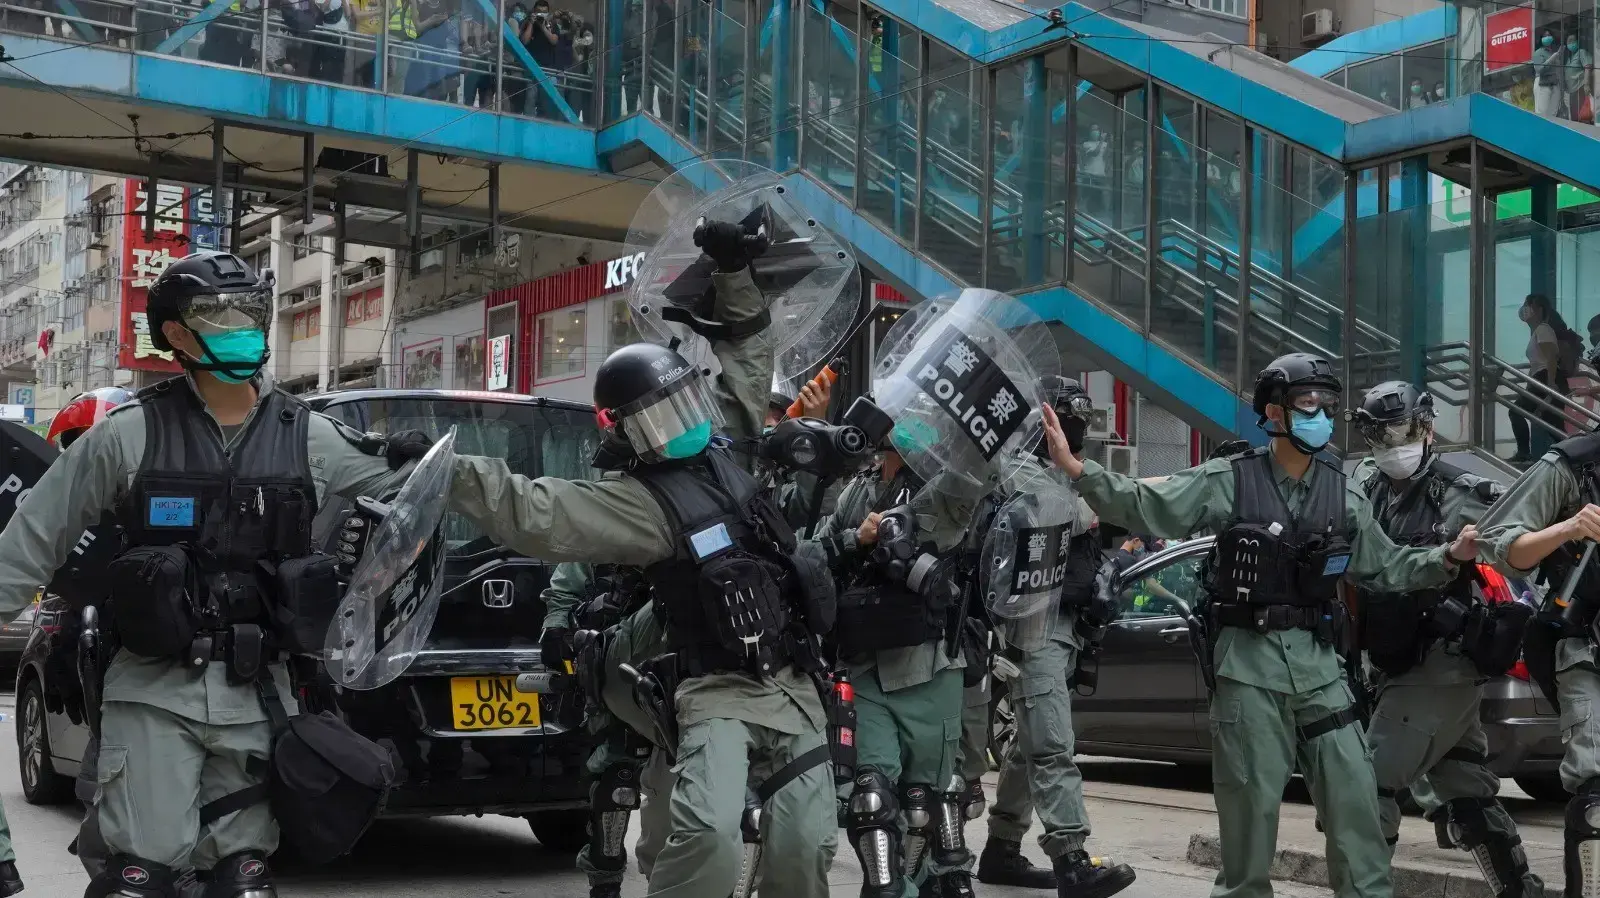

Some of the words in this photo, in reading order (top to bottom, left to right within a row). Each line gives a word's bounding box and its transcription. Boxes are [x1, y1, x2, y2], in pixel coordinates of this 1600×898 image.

[1491, 30, 1528, 46] OUTBACK
[604, 251, 646, 289] KFC
[657, 366, 684, 384] Police
[916, 363, 999, 453] POLICE
[165, 513, 178, 521] 2/2
[1016, 562, 1067, 589] POLICE
[475, 679, 513, 702] UN
[459, 702, 534, 726] 3062
